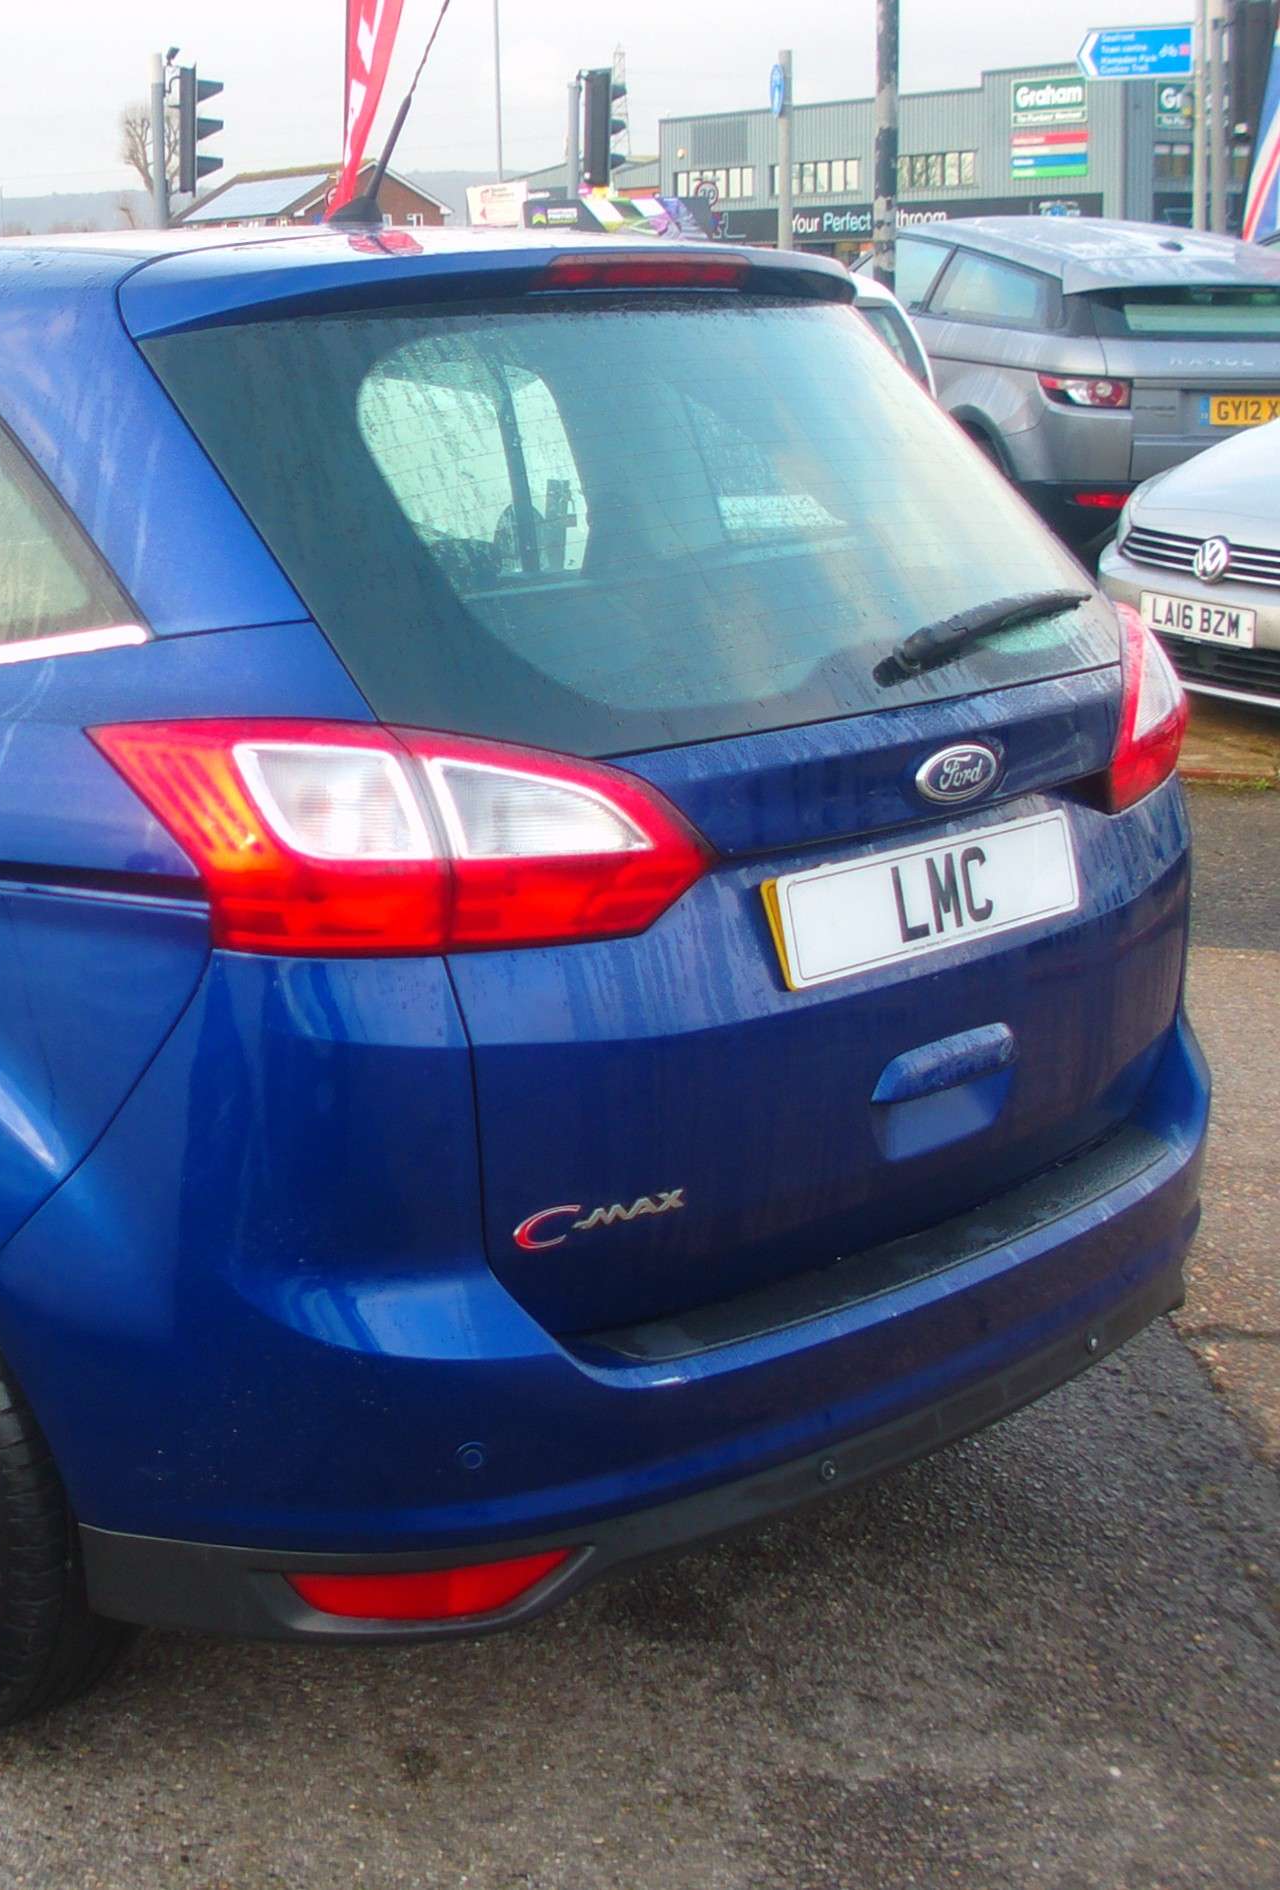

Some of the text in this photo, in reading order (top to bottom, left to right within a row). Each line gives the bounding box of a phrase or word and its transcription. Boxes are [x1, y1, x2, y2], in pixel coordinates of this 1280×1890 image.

[1015, 84, 1083, 108] Graham
[792, 208, 947, 233] Your Perfect throom
[1216, 400, 1262, 421] GY12
[1152, 598, 1240, 639] LA16 BZM
[939, 754, 984, 790] Ford
[890, 846, 993, 944] LMC
